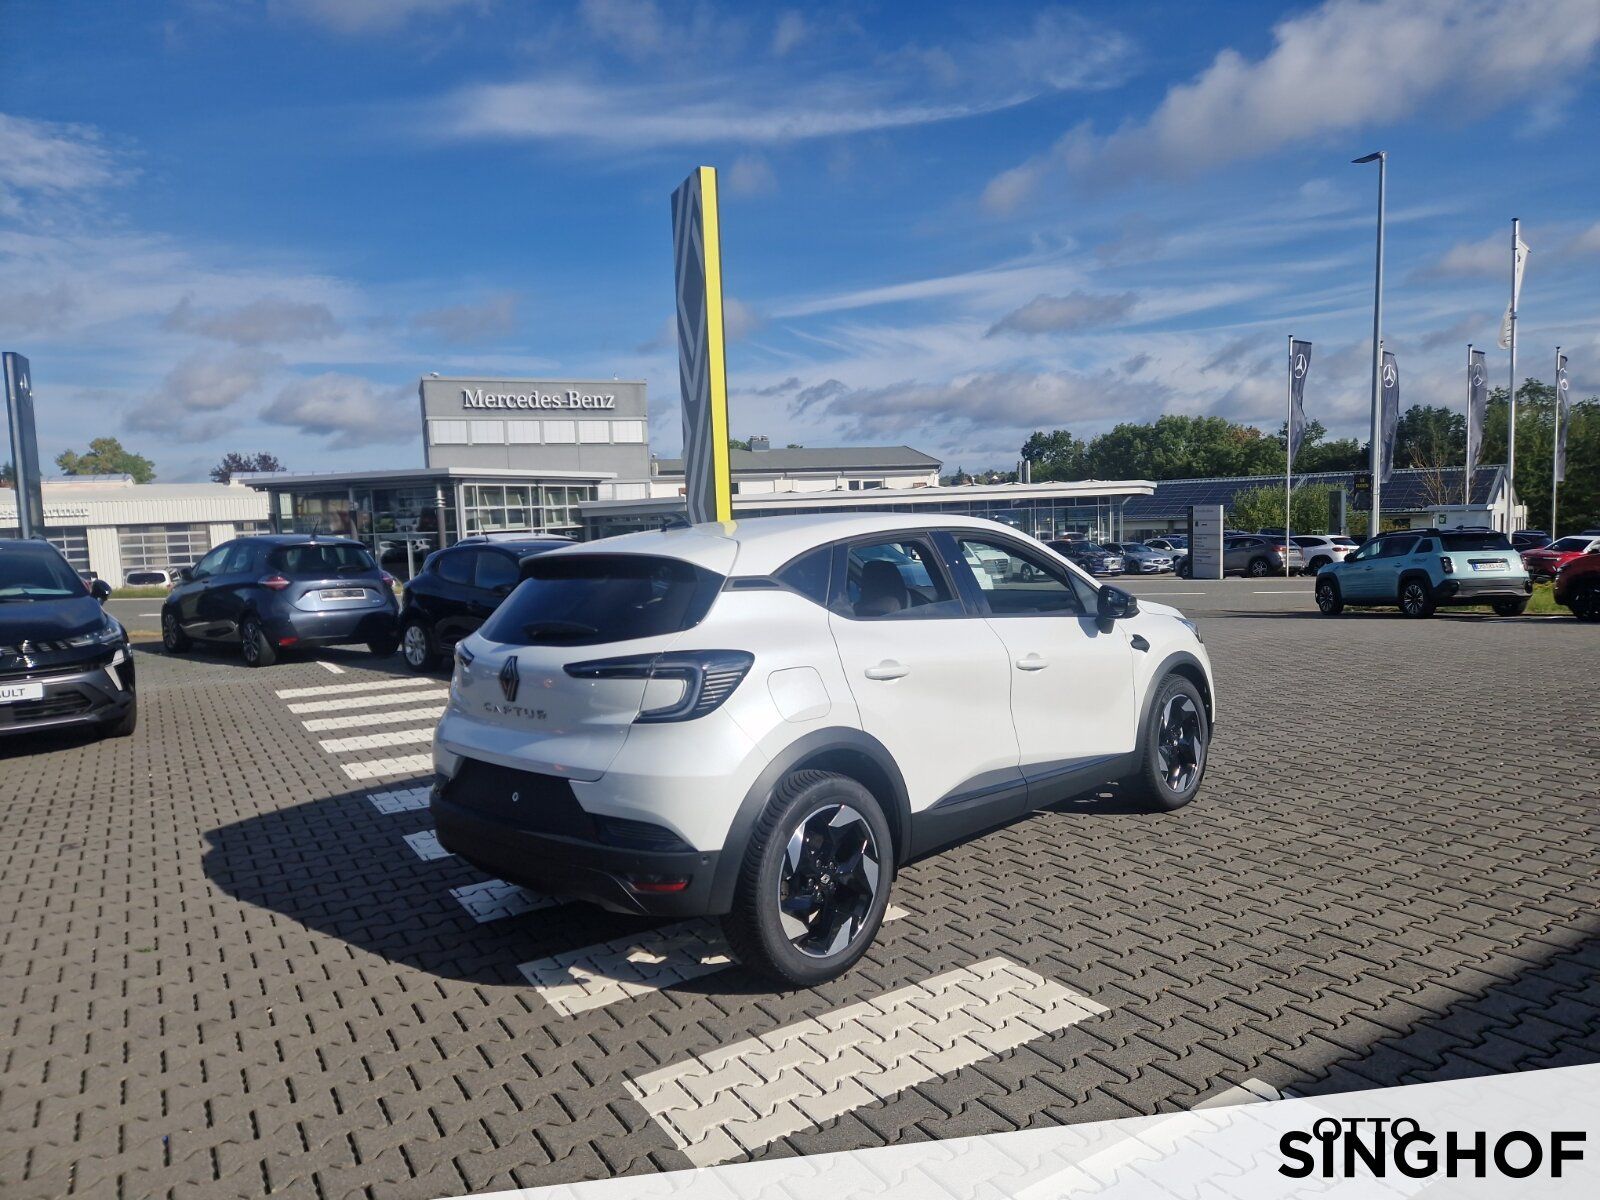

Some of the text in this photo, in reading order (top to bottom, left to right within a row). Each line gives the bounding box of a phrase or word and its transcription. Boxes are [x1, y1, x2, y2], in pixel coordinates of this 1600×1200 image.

[463, 388, 615, 409] Mercedes-Benz
[0, 687, 26, 699] ULT
[483, 702, 548, 720] CAPTUR
